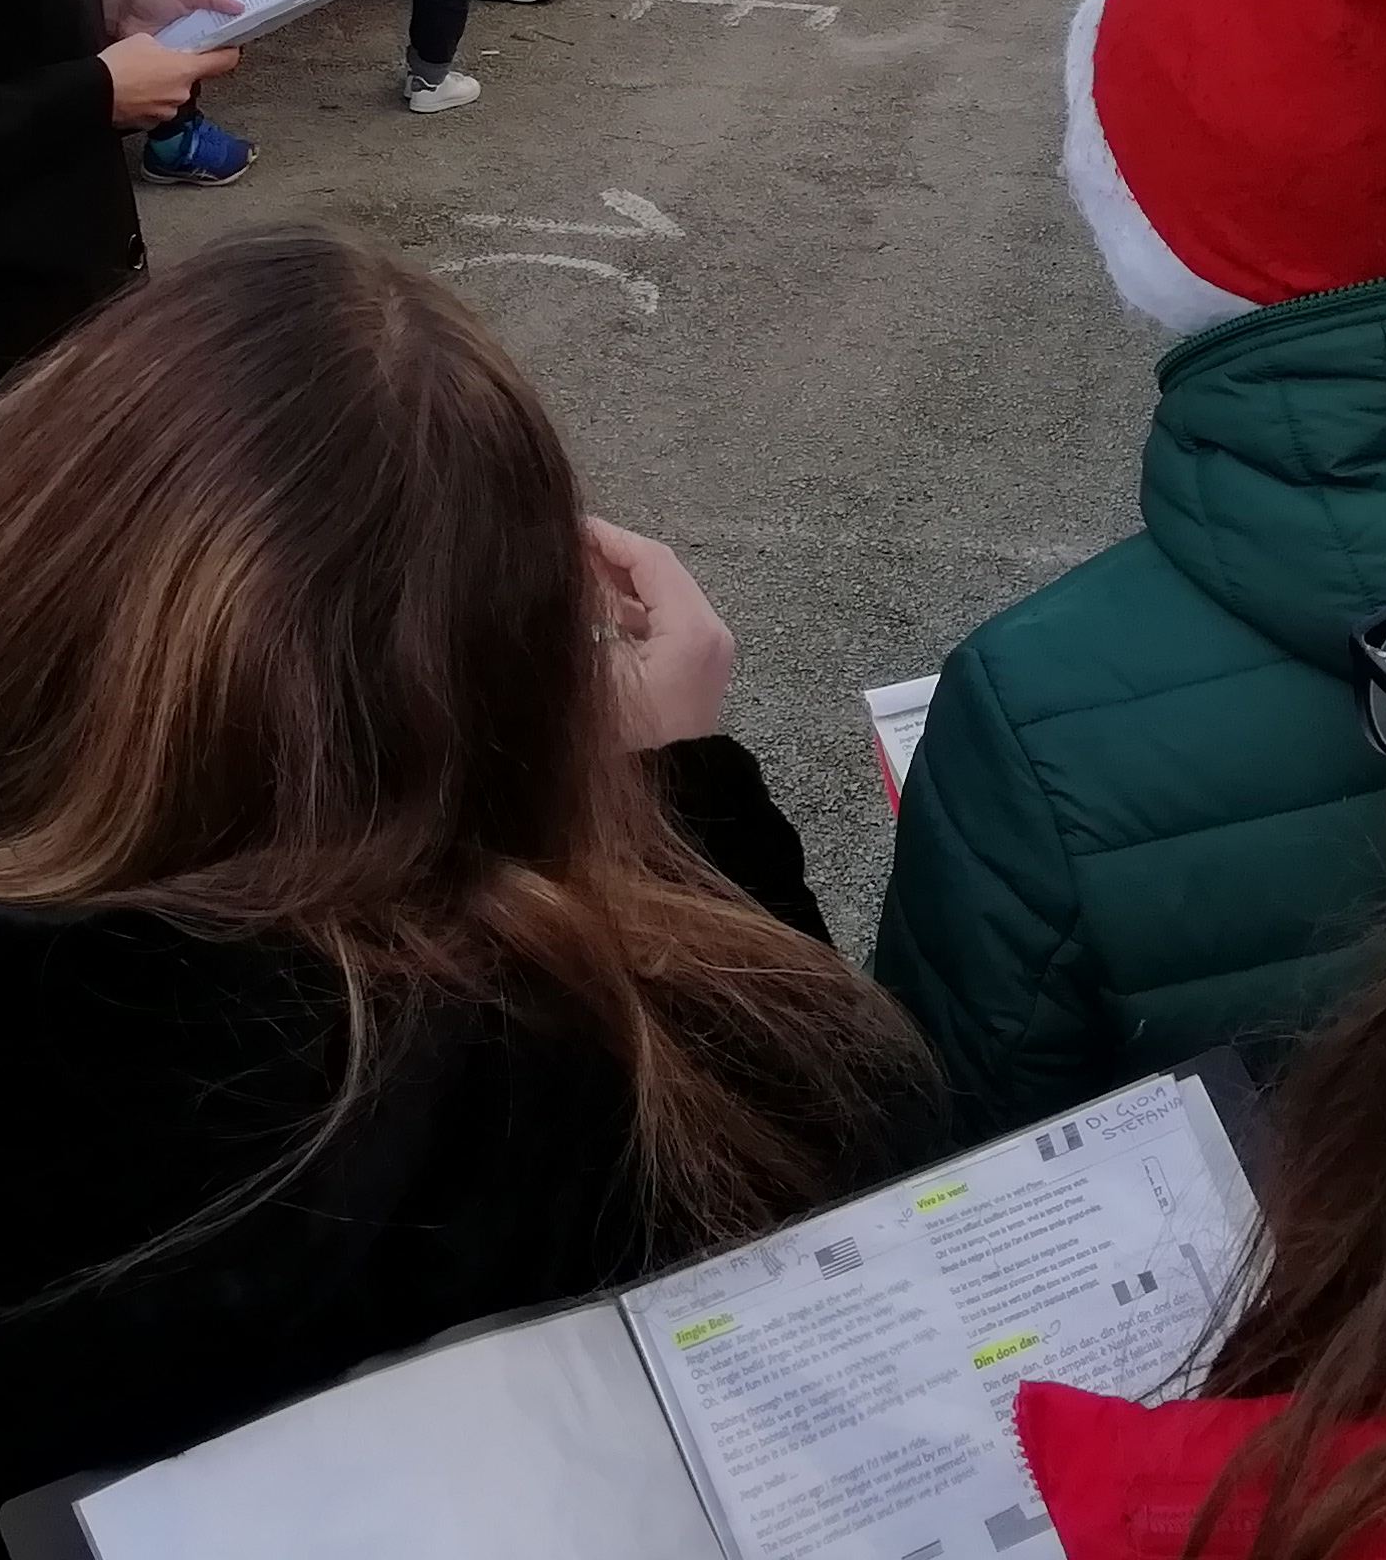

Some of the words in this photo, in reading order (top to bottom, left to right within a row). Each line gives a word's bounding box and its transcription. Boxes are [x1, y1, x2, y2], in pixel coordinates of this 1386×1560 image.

[1086, 1114, 1108, 1130] DI
[1102, 1096, 1183, 1140] STEFANIA
[916, 1197, 935, 1208] Vive
[936, 1193, 945, 1201] le
[676, 1324, 706, 1343] Jingle
[707, 1313, 733, 1329] Bells
[709, 1356, 732, 1371] what
[733, 1350, 749, 1362] fun
[767, 1337, 779, 1347] to
[780, 1329, 797, 1341] ride
[973, 1355, 994, 1369] Din
[996, 1345, 1017, 1359] don
[1019, 1335, 1039, 1349] dan
[982, 1380, 1001, 1392] Din
[1001, 1371, 1021, 1384] don
[1043, 1353, 1058, 1365] din
[1059, 1344, 1078, 1358] don
[1100, 1327, 1115, 1339] din
[1116, 1315, 1135, 1331] don
[1136, 1310, 1152, 1323] din
[721, 1385, 744, 1401] what
[744, 1379, 761, 1391] fun
[779, 1366, 790, 1376] to
[791, 1357, 810, 1371] ride
[1071, 1372, 1090, 1387] don
[710, 1413, 746, 1433] Dashing
[783, 1389, 799, 1401] the
[777, 1410, 792, 1421] we
[727, 1461, 753, 1476] What
[754, 1454, 770, 1466] fun
[800, 1432, 817, 1446] ride
[744, 1442, 758, 1454] on
[921, 1450, 934, 1462] by
[936, 1443, 951, 1456] my
